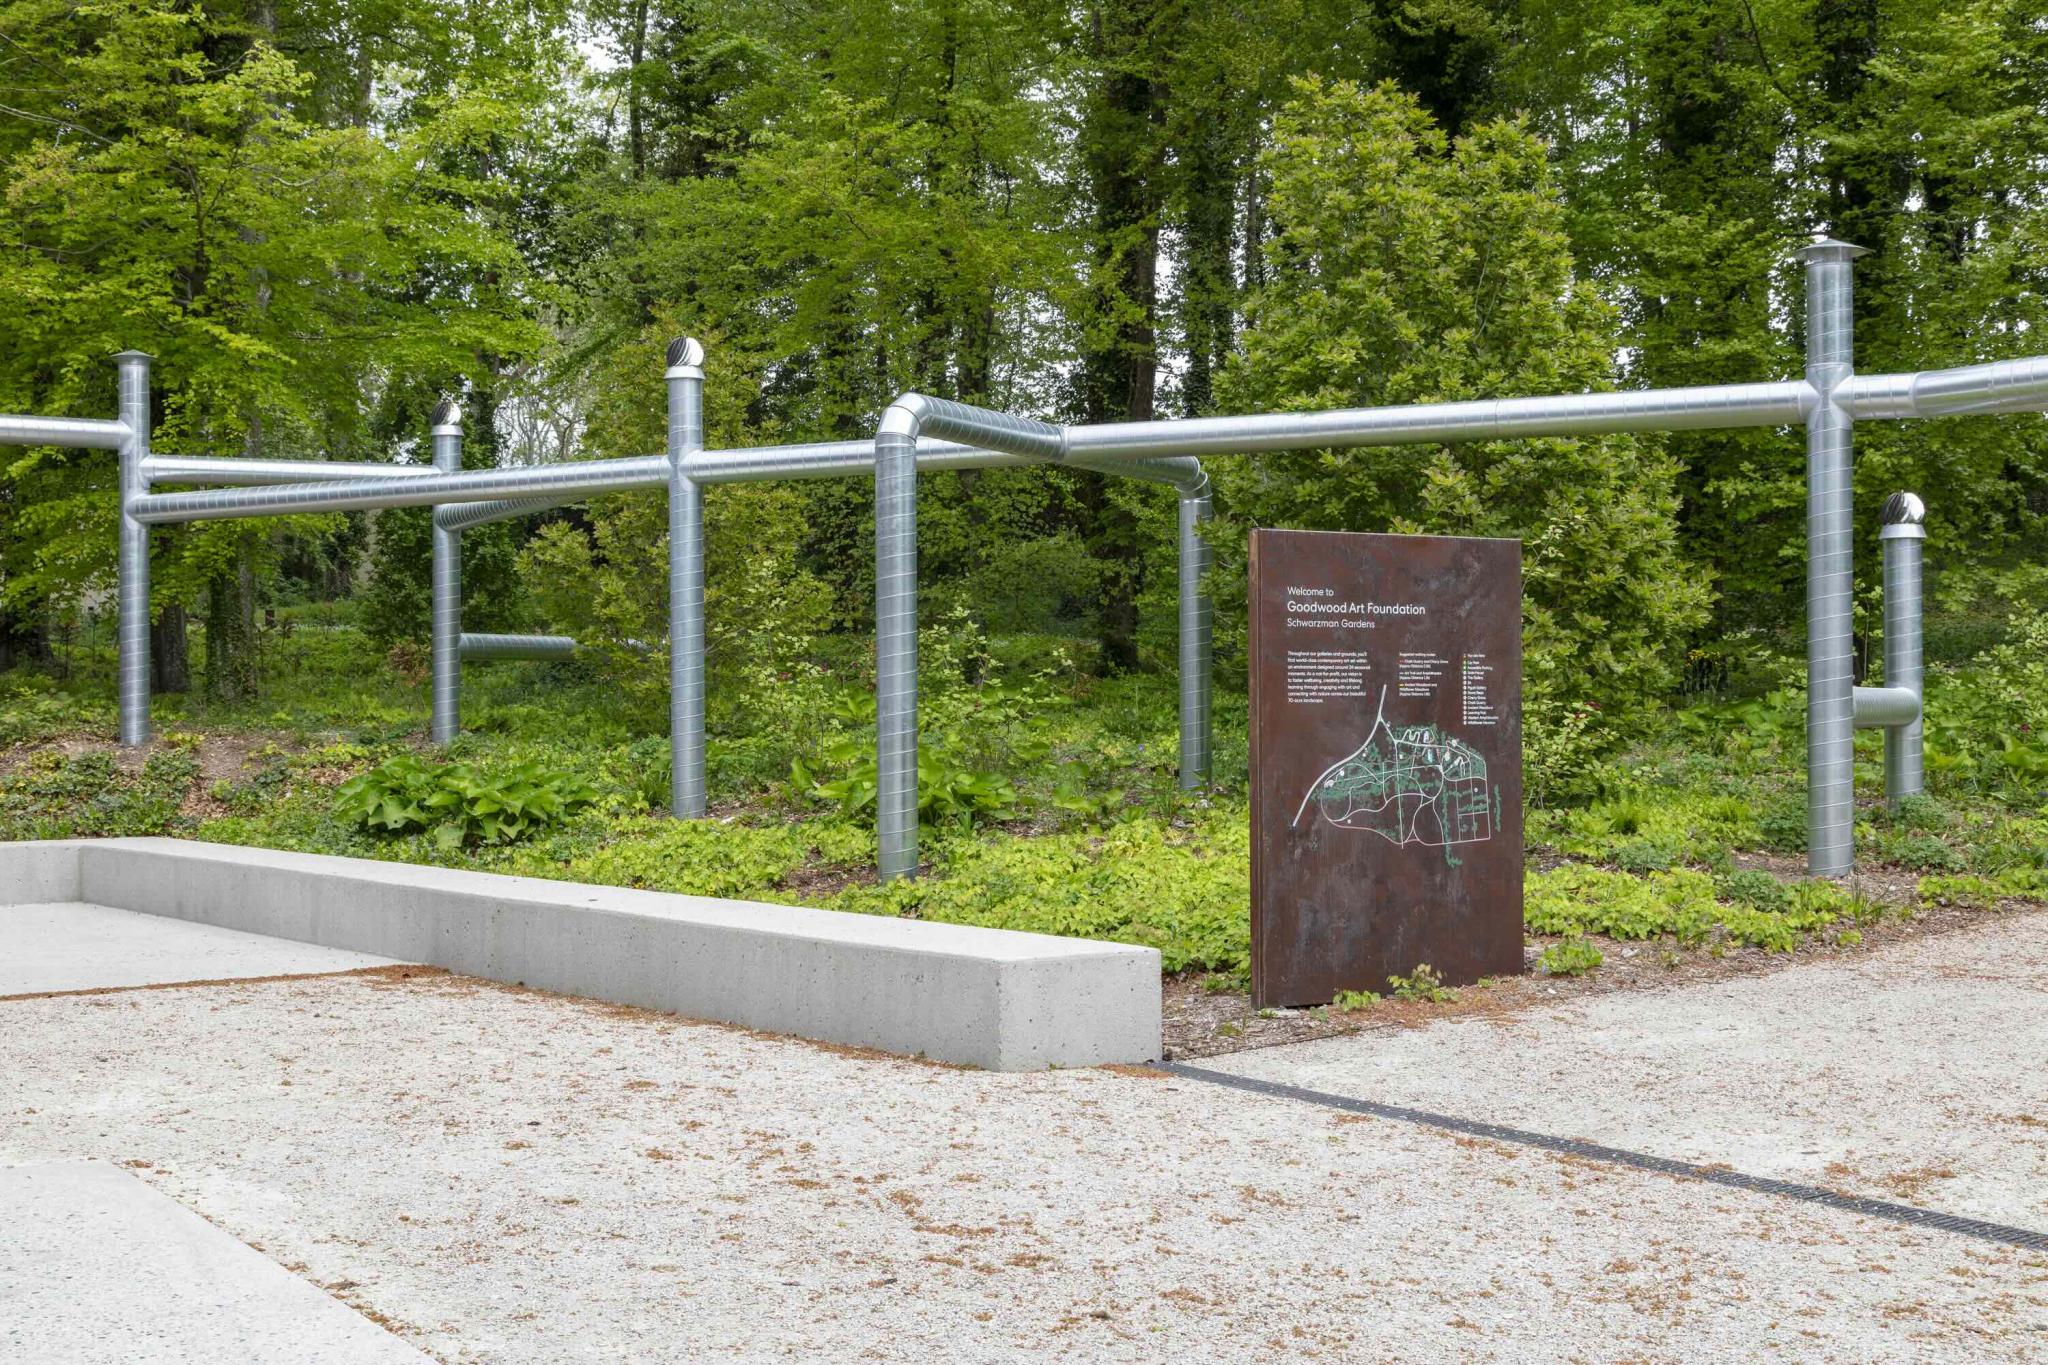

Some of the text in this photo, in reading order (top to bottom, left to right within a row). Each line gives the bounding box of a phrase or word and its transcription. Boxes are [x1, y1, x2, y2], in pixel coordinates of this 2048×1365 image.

[1287, 586, 1334, 597] Welcome to
[1287, 600, 1426, 615] Goodwood Art Foundation
[1287, 618, 1376, 629] Schwarzman Gardens
